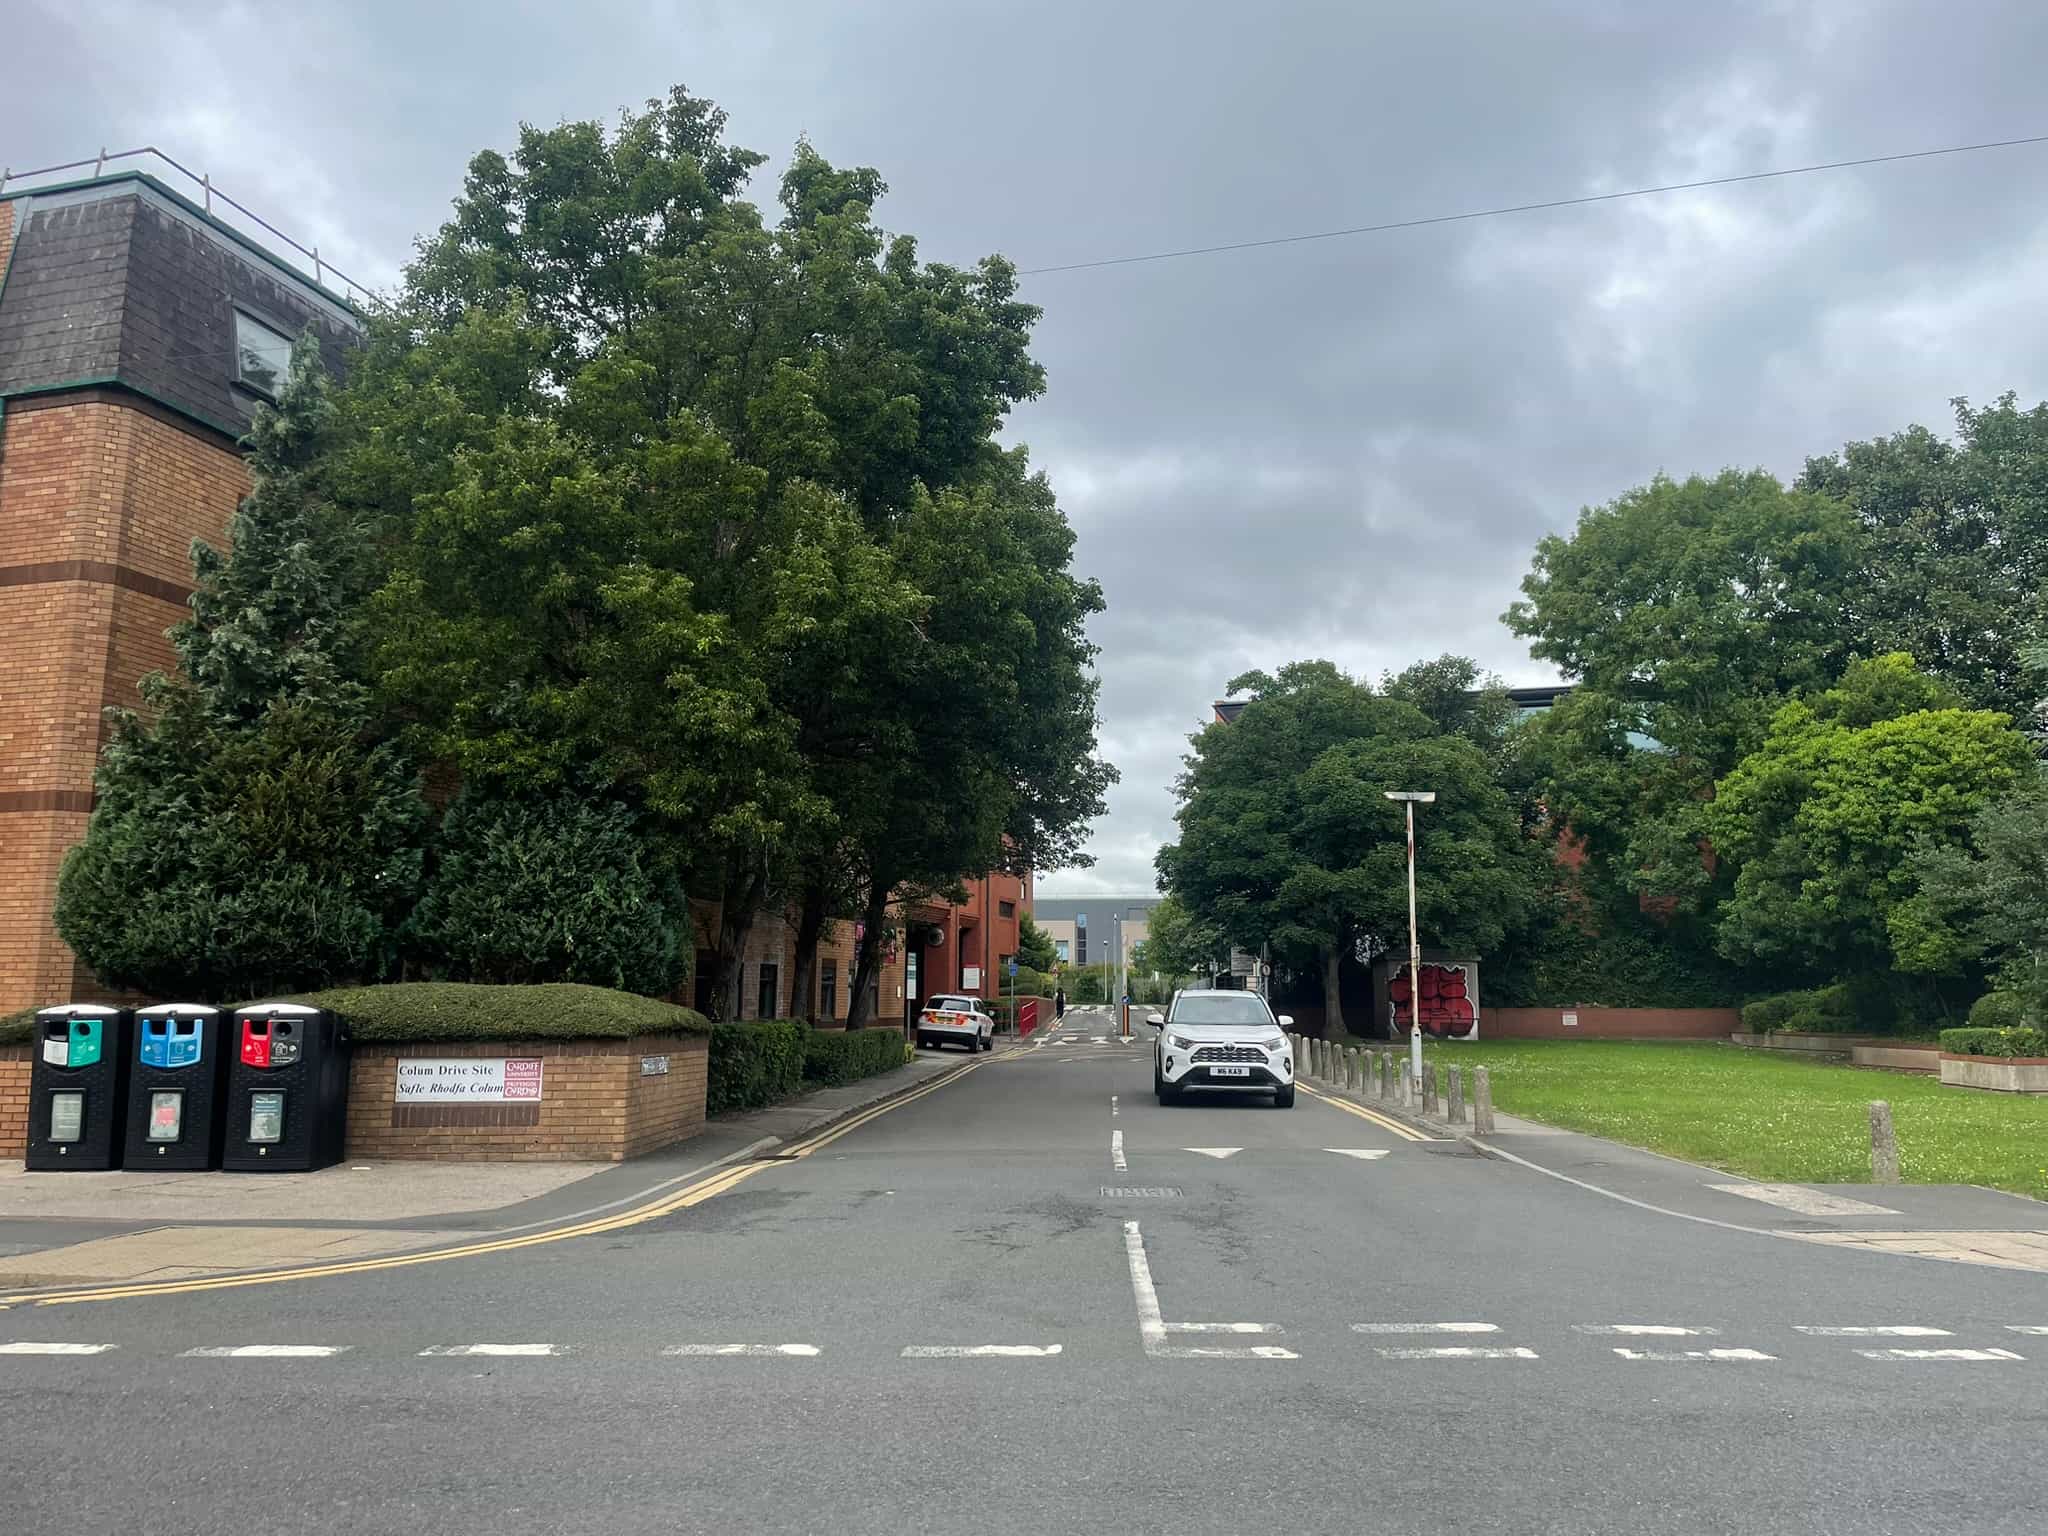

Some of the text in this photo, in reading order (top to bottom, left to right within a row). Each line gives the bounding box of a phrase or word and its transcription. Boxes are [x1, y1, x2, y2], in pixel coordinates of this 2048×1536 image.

[399, 1065, 433, 1076] Colum
[440, 1065, 468, 1076] Drive
[472, 1065, 494, 1076] Site
[399, 1084, 425, 1095] Safle
[430, 1083, 466, 1095] Rhodfa
[470, 1083, 504, 1094] Colum
